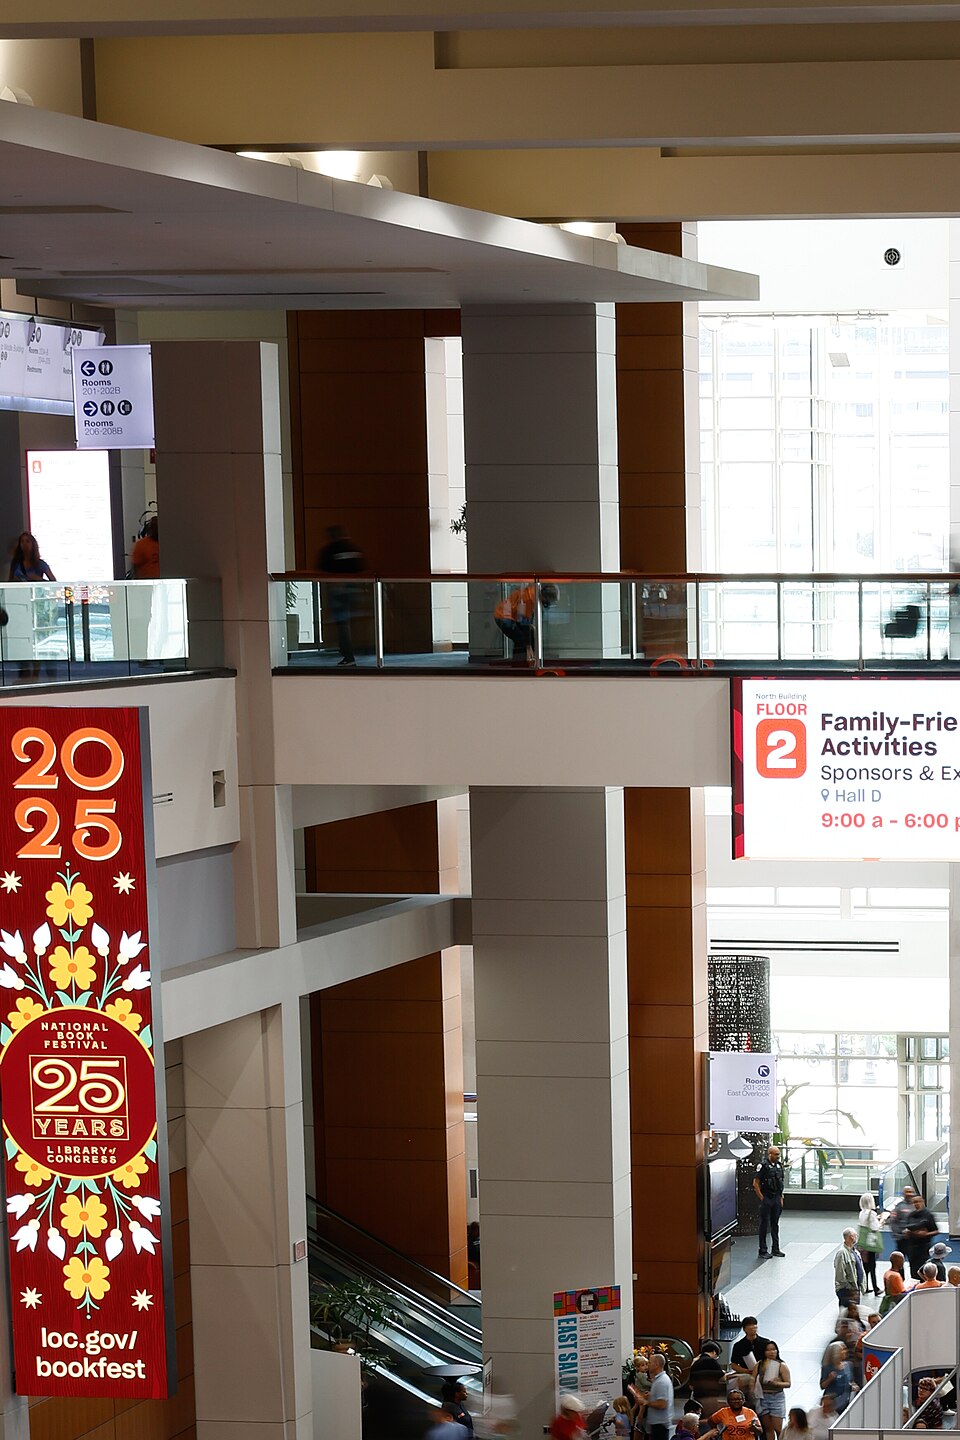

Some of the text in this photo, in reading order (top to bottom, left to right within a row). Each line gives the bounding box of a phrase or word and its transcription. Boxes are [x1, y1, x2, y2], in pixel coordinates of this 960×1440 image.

[82, 379, 112, 387] Rooms
[778, 693, 807, 701] Building
[757, 704, 807, 715] FLOOR
[766, 730, 797, 769] 2
[821, 736, 938, 756] Activities
[11, 727, 125, 792] 20
[821, 765, 912, 784] Sponsors
[919, 765, 934, 781] &
[836, 789, 882, 802] Hall D
[14, 796, 123, 861] 25
[821, 813, 865, 828] 9:00
[872, 817, 883, 828] a
[904, 813, 949, 828] 6:00
[41, 1022, 108, 1031] NATIONAL
[57, 1031, 94, 1040] BOOK
[44, 1040, 108, 1050] FESTIVAL
[32, 1058, 125, 1114] 25
[35, 1118, 125, 1136] YEARS
[47, 1146, 107, 1154] LIBRARY
[47, 1154, 117, 1164] CONGRESS
[41, 1327, 138, 1355] loc.gov/
[558, 1318, 578, 1349] EAST
[36, 1355, 146, 1379] bookfest
